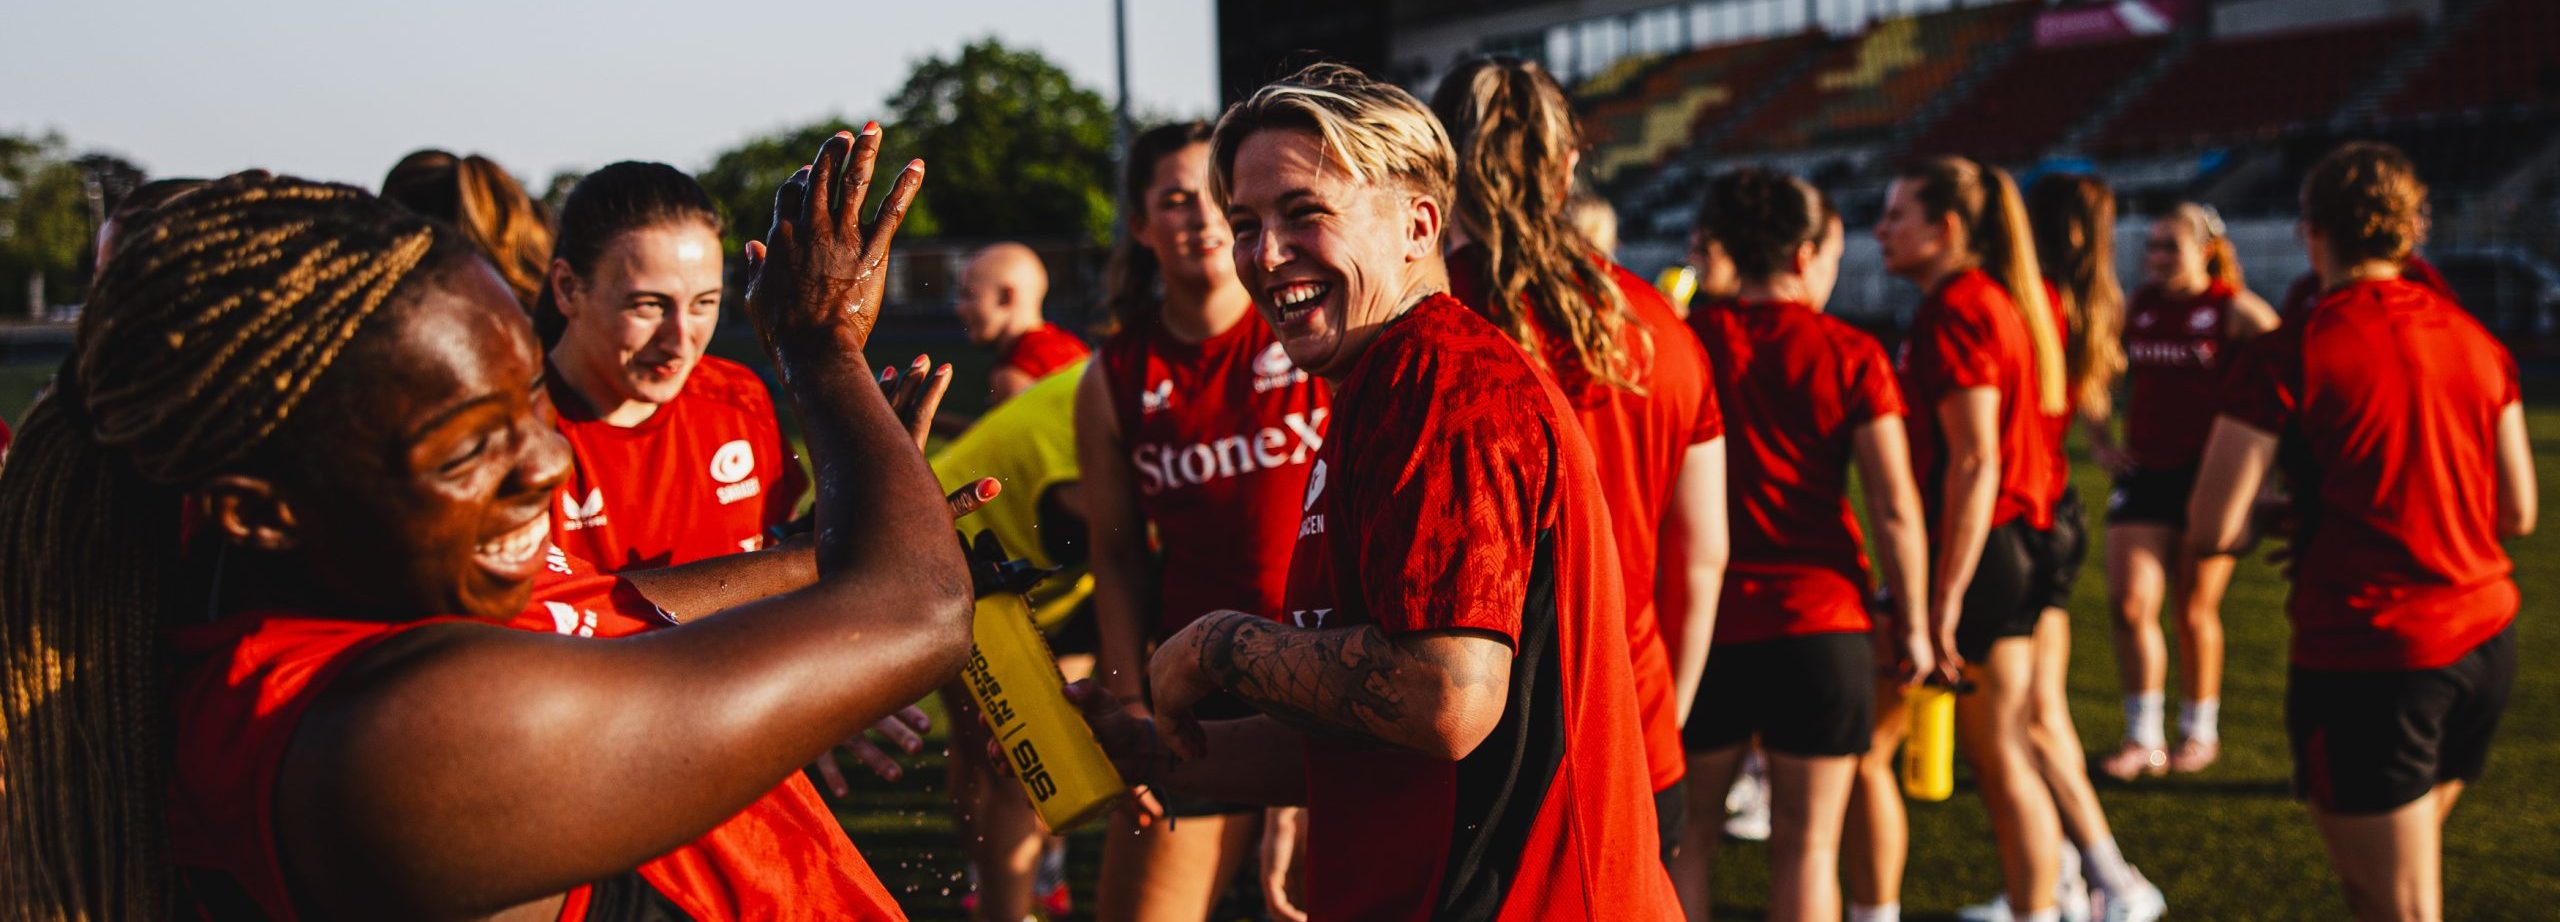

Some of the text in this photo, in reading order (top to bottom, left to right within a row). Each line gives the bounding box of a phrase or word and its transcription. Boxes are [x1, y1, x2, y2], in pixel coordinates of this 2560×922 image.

[1132, 406, 1329, 495] StoneX
[966, 657, 1005, 727] SCIENC
[969, 642, 1016, 721] IN SPOR
[1012, 738, 1057, 803] SIS
